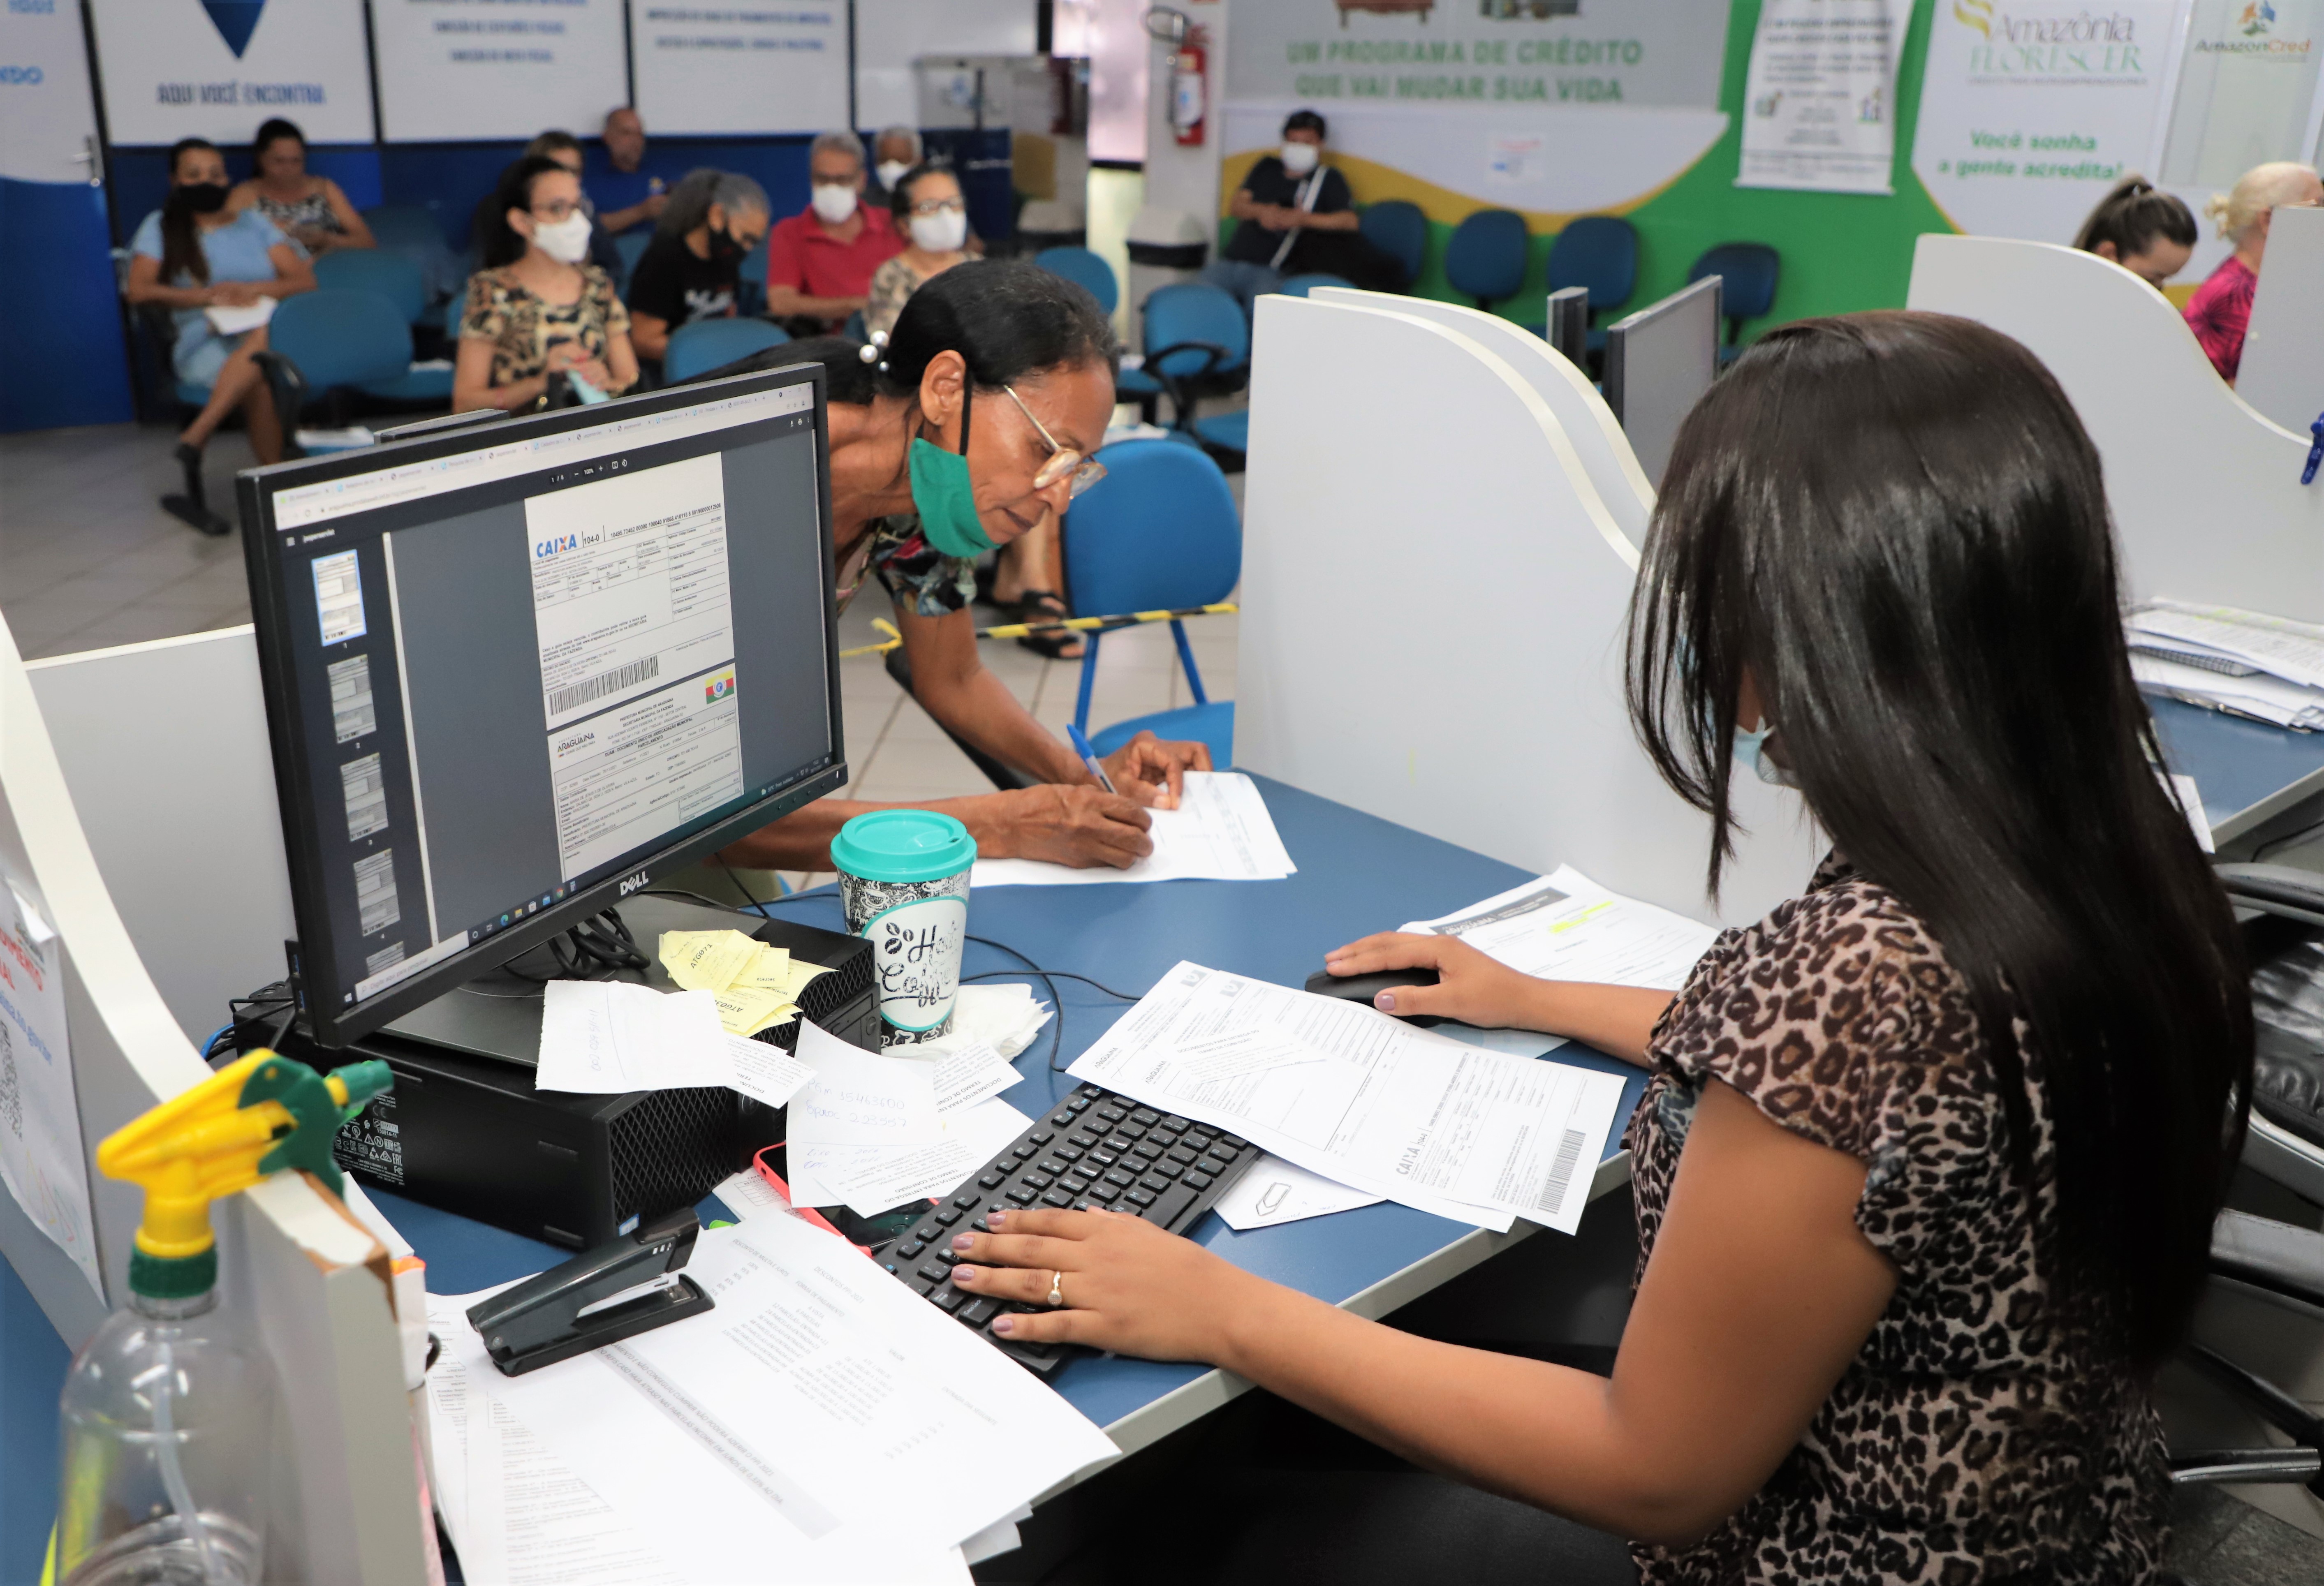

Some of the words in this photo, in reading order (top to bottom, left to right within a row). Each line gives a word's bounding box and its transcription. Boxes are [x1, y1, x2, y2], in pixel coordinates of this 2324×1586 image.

[1989, 10, 2135, 43] Amazônia
[1327, 40, 1470, 65] PROGRAMA
[1478, 40, 1508, 65] DE
[1516, 35, 1642, 65] CRÉDITO
[157, 82, 192, 104] AQUI
[200, 81, 238, 105] VOCÊ
[1493, 77, 1546, 102] SUA
[1558, 78, 1623, 103] VIDA
[1970, 129, 2023, 150] Você
[2030, 132, 2098, 152] sonha
[536, 534, 577, 558] CAIXA
[583, 534, 600, 545] 104-0
[557, 732, 595, 753] ARAGUAÍNA
[617, 740, 637, 752] DOCUMENTO
[653, 723, 676, 737] ARRECADAÇÃO
[676, 717, 693, 726] MUNICIPAL
[637, 735, 663, 748] PARCELAMENTO
[619, 870, 649, 896] DELL
[907, 920, 960, 965] Hot
[690, 943, 713, 969] ATG071
[877, 962, 958, 1008] Coffee
[1177, 1040, 1213, 1054] DOCUMENTOS
[1228, 1031, 1251, 1041] ENTREGA
[1225, 1037, 1252, 1049] CONFISSÃO
[960, 1079, 981, 1094] TERMO
[962, 1076, 1002, 1102] DOCUMENTOS
[947, 1098, 963, 1110] PARA
[1396, 1145, 1420, 1176] CAIXA
[936, 1168, 959, 1179] TERMO
[893, 1178, 929, 1194] CONFISSÃO
[893, 1187, 923, 1200] ENTREGA
[922, 1181, 939, 1191] PARA
[814, 1265, 844, 1289] DESCONTOS
[841, 1285, 866, 1304] PPI-2021
[794, 1280, 812, 1294] FORMA
[816, 1295, 846, 1318] PAGAMENTO
[799, 1310, 822, 1328] PARCELAS
[887, 1348, 906, 1362] VALOR
[639, 1382, 662, 1400] ATRASO
[667, 1406, 695, 1428] PARCELAS
[690, 1426, 717, 1446] INCORRE
[720, 1452, 743, 1468] JUROS
[644, 1369, 676, 1394] CONSEGUIU
[671, 1392, 698, 1412] CUMPRIR
[725, 1437, 748, 1454] ADERIR
[757, 1463, 775, 1477] 2021
